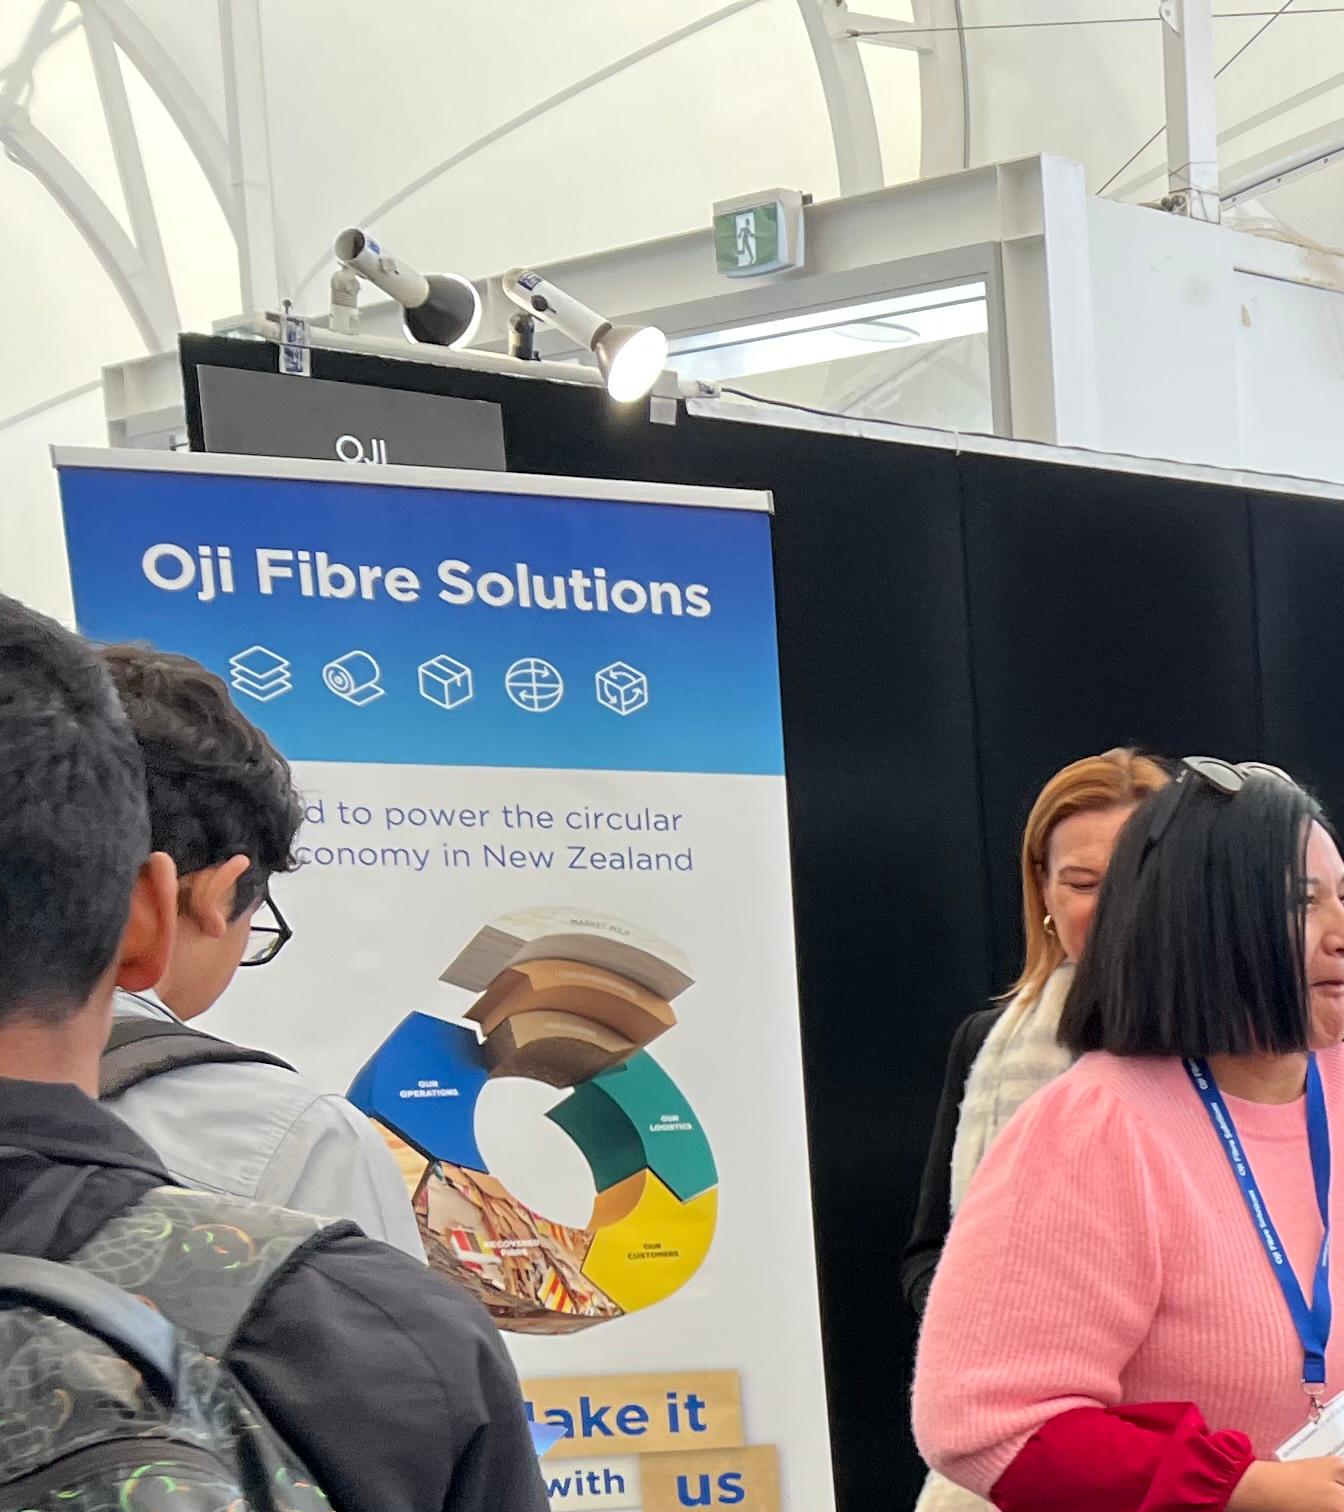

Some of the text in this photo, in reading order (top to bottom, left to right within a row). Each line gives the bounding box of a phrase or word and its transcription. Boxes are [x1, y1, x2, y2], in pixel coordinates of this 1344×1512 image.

[142, 543, 712, 618] Oji Fibre Solutions
[337, 801, 372, 825] to
[385, 806, 490, 830] power
[501, 804, 554, 829] the
[565, 806, 683, 832] circular
[295, 843, 693, 872] conomy in New Zealand
[666, 1392, 707, 1433] it
[546, 1468, 746, 1508] with us
